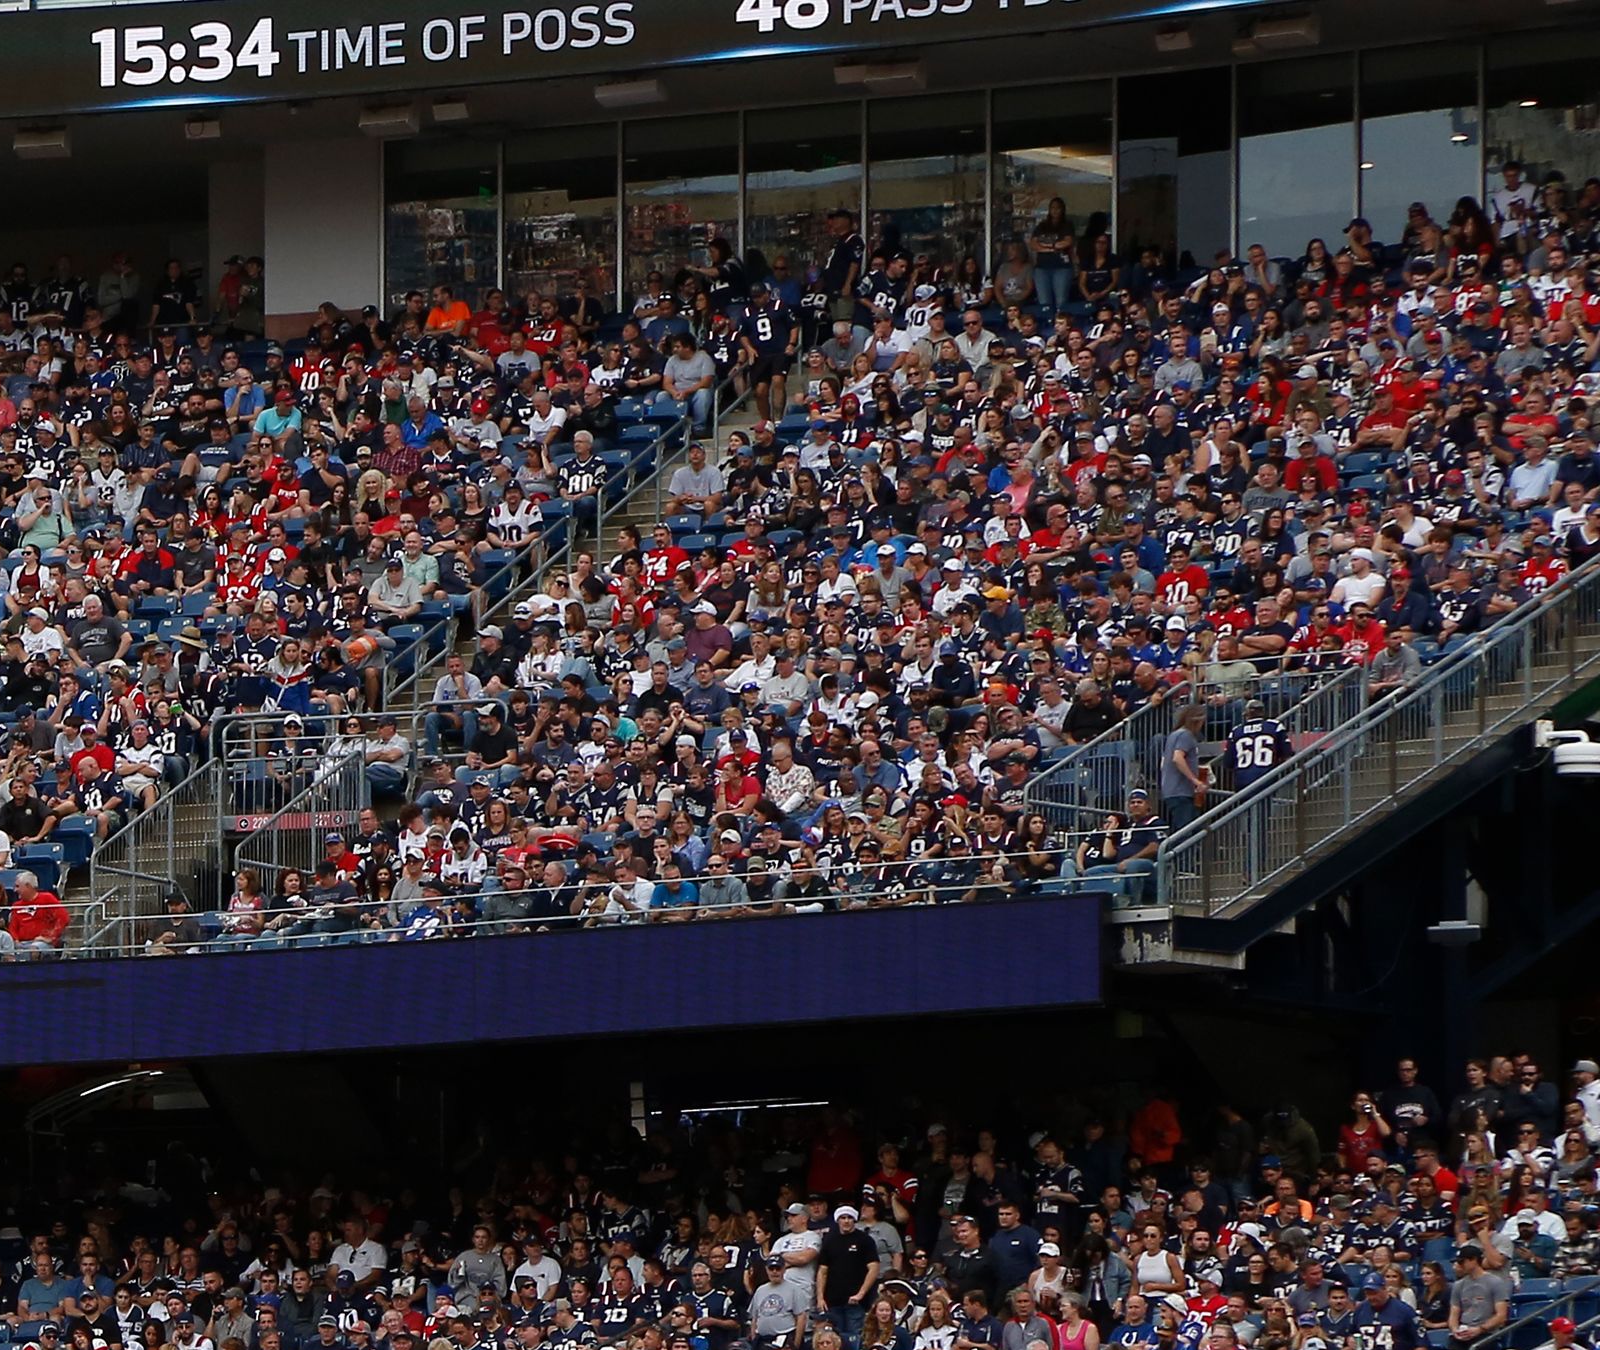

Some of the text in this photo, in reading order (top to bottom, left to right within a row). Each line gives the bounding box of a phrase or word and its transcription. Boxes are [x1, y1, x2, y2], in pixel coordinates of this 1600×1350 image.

[92, 3, 634, 86] 15:34 TIME OF POSS
[12, 302, 29, 321] 12
[757, 318, 771, 340] 9
[565, 473, 594, 495] 80
[1166, 581, 1189, 606] 10
[1236, 735, 1273, 767] 66
